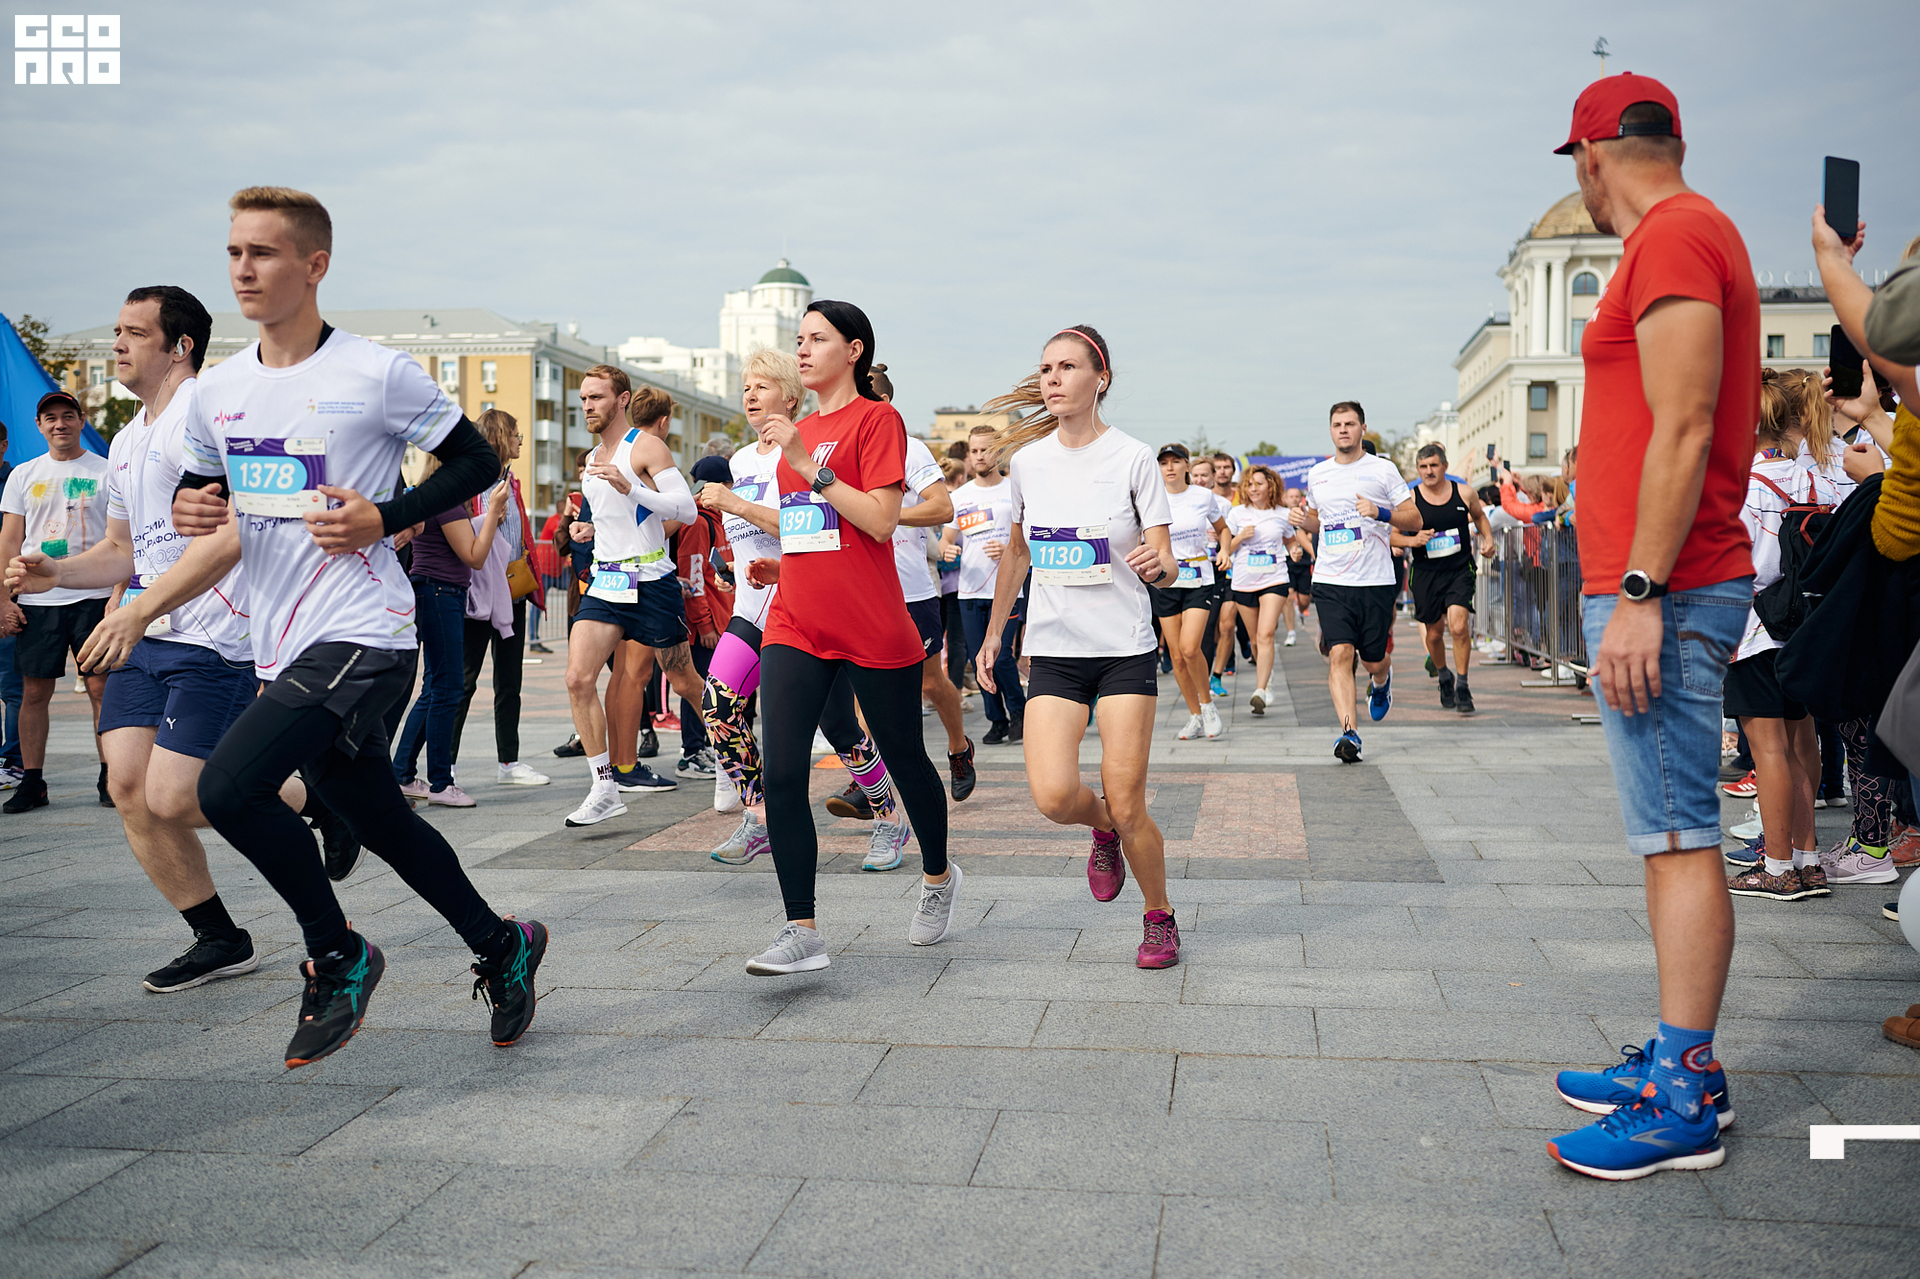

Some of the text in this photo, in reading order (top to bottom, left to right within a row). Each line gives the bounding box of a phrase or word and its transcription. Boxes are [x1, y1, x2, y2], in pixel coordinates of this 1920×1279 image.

[240, 462, 296, 489] 1378
[783, 510, 814, 532] 1391
[961, 512, 985, 528] 5178
[1328, 532, 1348, 544] 1156
[1430, 538, 1450, 550] 1102
[1040, 546, 1083, 566] 1130
[600, 575, 626, 589] 1347
